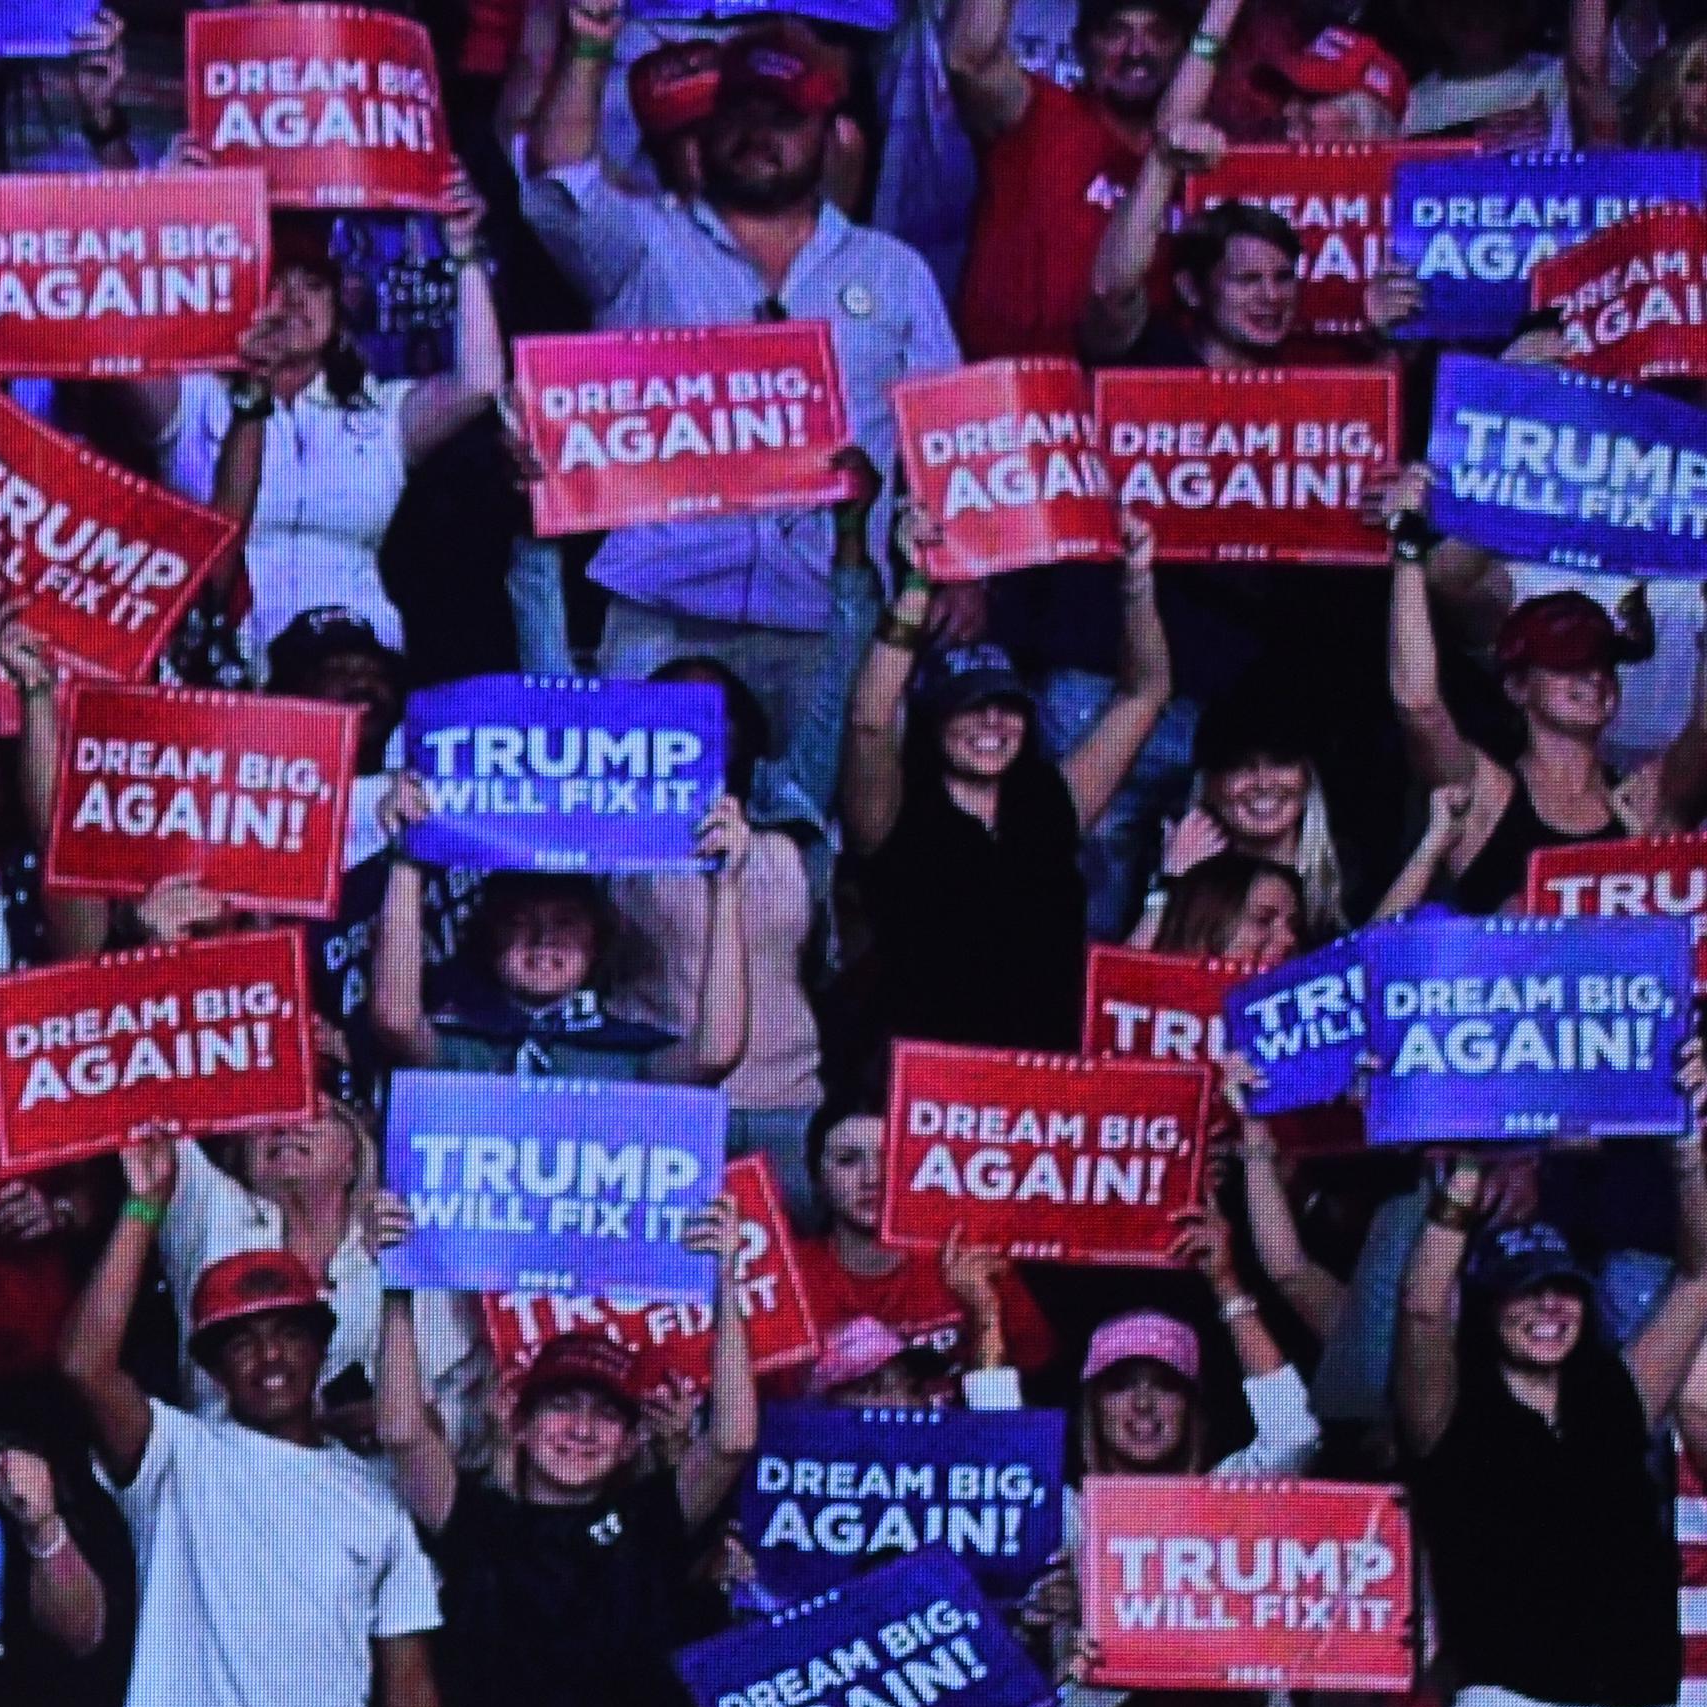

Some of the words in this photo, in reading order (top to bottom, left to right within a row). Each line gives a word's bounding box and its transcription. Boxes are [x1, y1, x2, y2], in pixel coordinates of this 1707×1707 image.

[205, 59, 366, 97] DREAM
[214, 98, 433, 150] AGAIN!
[542, 372, 715, 422] DREAM
[561, 402, 805, 473] AGAIN!
[1111, 421, 1280, 458] DREAM
[1122, 462, 1364, 509] AGAIN!
[1450, 467, 1564, 512] WILL
[1581, 488, 1652, 532] FIX
[39, 561, 100, 612] FIX
[109, 590, 160, 631] IT
[74, 738, 223, 785] DREAM
[423, 727, 701, 778] TRUMP
[73, 780, 307, 851] AGAIN!
[422, 778, 544, 815] WILL
[560, 780, 637, 816] FIX
[651, 778, 699, 815] IT
[1384, 976, 1563, 1020] DREAM
[6, 994, 181, 1059] DREAM
[1390, 1018, 1657, 1078] AGAIN!
[19, 1022, 275, 1111] AGAIN!
[908, 1101, 1085, 1150] DREAM
[409, 1134, 702, 1203] TRUMP
[910, 1144, 1167, 1207] AGAIN!
[409, 1191, 535, 1234] WILL
[546, 1200, 634, 1240] FIX
[756, 1455, 938, 1500] DREAM
[760, 1502, 1021, 1556] AGAIN!
[1107, 1537, 1396, 1598] TRUMP
[1110, 1593, 1241, 1632] WILL
[1252, 1593, 1333, 1631] FIX
[1347, 1595, 1394, 1632] IT
